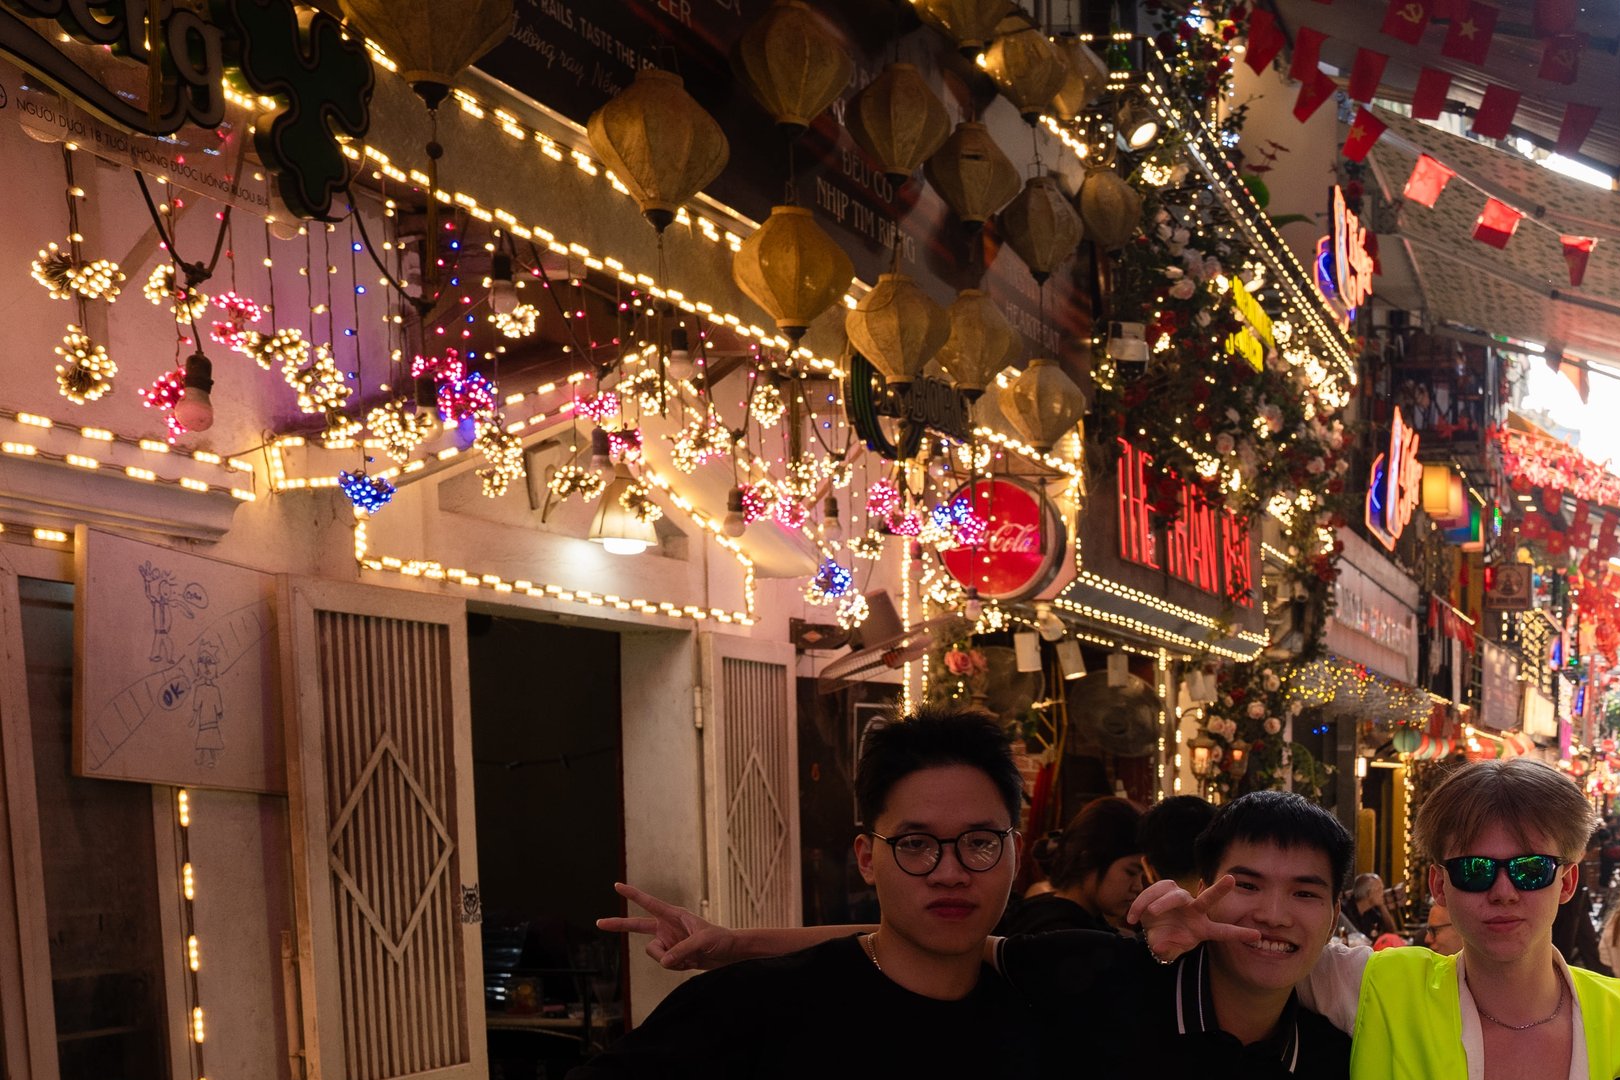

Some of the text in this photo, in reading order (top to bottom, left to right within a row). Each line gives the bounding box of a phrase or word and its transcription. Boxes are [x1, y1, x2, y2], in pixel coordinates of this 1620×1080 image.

[579, 15, 613, 55] TASTE
[852, 200, 875, 238] TIM
[162, 681, 185, 707] OK
